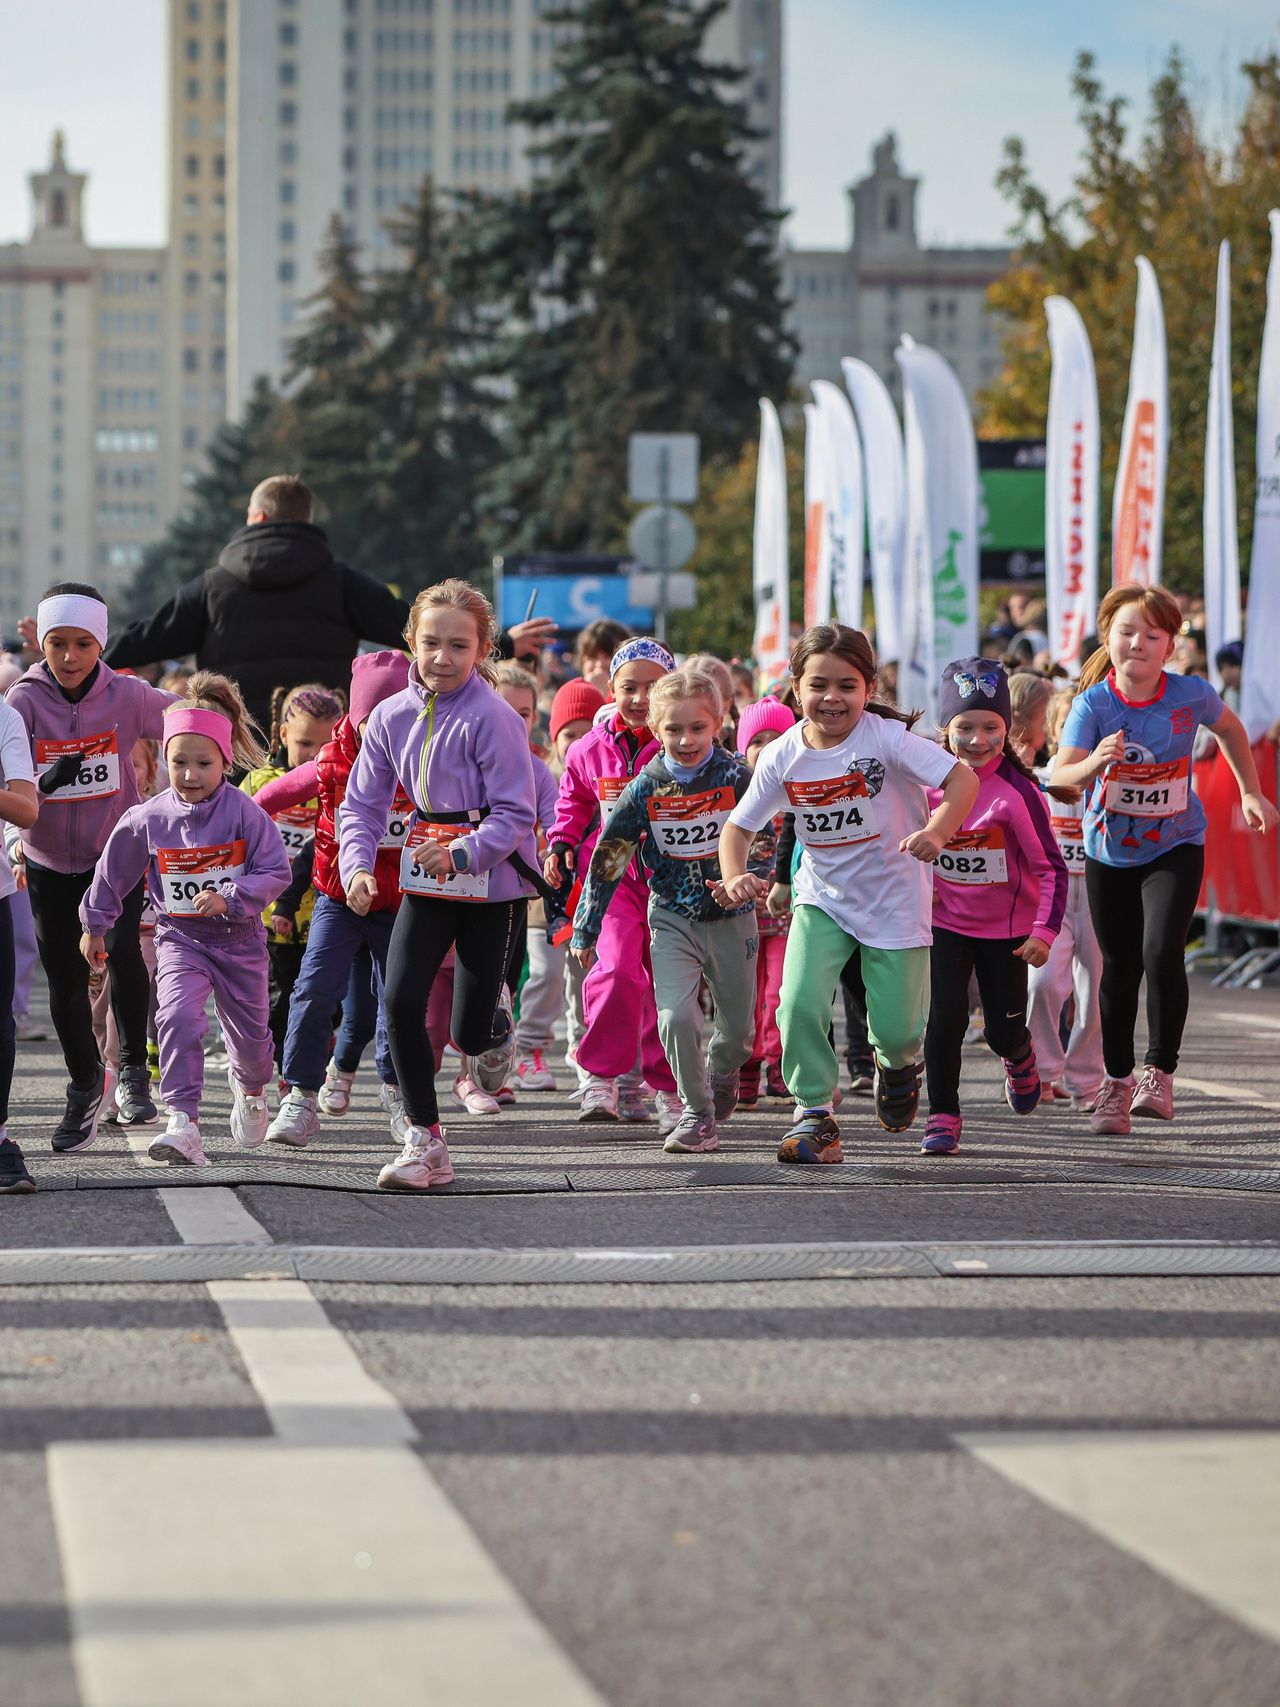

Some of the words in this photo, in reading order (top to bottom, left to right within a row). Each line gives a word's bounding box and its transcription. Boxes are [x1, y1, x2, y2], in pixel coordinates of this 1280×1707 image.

[1121, 788, 1169, 805] 3141
[802, 807, 864, 832] 3274
[662, 822, 720, 845] 3222
